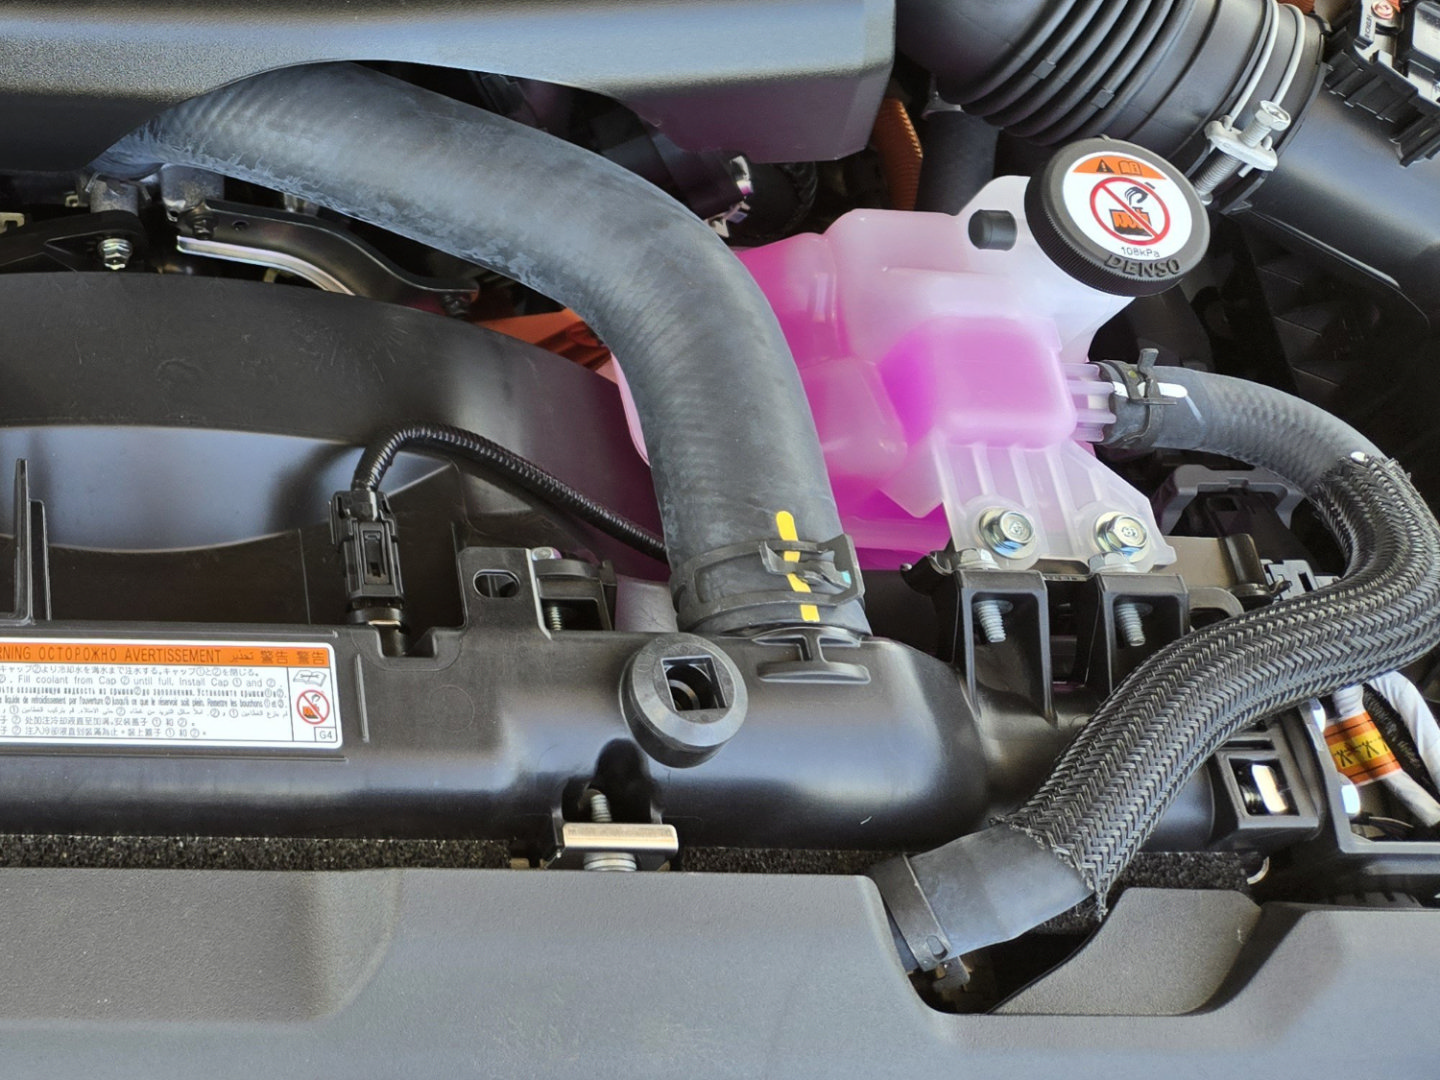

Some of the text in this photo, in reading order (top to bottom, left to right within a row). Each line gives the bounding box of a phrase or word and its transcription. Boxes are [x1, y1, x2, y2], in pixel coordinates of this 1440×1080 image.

[1104, 254, 1180, 278] DENSO
[39, 647, 117, 661] ОСТОРОЖНО
[125, 648, 221, 663] AVERTISSEMENT
[261, 651, 288, 664] 警告
[18, 675, 31, 683] Fill
[36, 676, 68, 684] coolant
[74, 676, 93, 685] from
[99, 676, 116, 685] Cap
[133, 677, 152, 685] until
[180, 678, 205, 687] Install
[211, 678, 229, 687] Cap
[246, 679, 262, 688] and
[319, 731, 333, 740] G4
